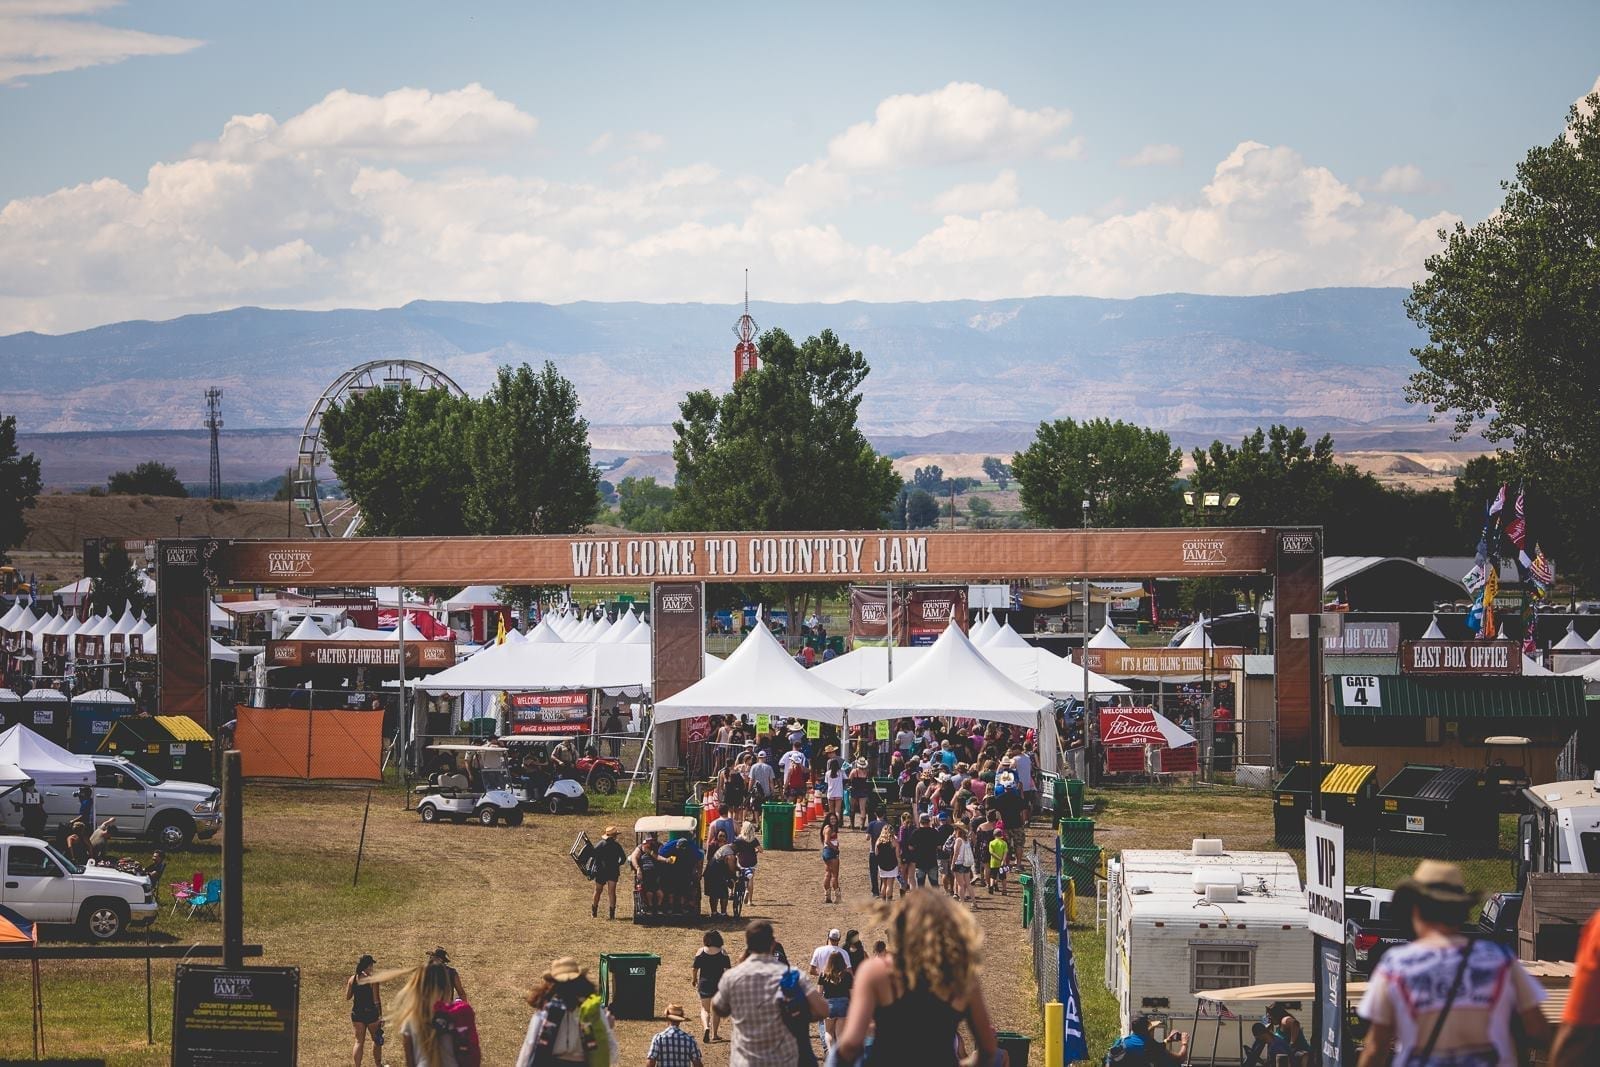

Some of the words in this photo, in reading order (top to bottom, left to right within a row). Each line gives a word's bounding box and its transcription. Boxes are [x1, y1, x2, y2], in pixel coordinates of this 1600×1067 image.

[1182, 542, 1225, 551] COUNTRY
[1282, 542, 1301, 552] JAM
[166, 553, 185, 562] JAM
[268, 552, 312, 561] COUNTRY
[570, 540, 695, 577] WELCOME
[704, 539, 738, 575] TO
[749, 538, 866, 574] COUNTRY
[873, 537, 928, 573] JAM
[1182, 549, 1207, 561] JAM
[268, 560, 295, 573] JAM
[662, 595, 693, 603] COUNTRY
[662, 602, 681, 610] JAM
[862, 604, 885, 612] COUNTRY
[862, 610, 876, 621] JAM
[922, 608, 939, 619] JAM
[317, 648, 347, 664] CACTUS
[348, 648, 381, 664] FLOWER
[383, 648, 401, 664] HAT
[1414, 646, 1441, 667] EAST
[1444, 646, 1467, 667] BOX
[1470, 646, 1508, 667] OFFICE
[1121, 657, 1135, 671] IT'S
[1136, 657, 1141, 671] A
[1142, 657, 1159, 671] GIRL
[1160, 657, 1181, 671] BLING
[1182, 656, 1204, 671] THING
[1346, 676, 1375, 687] GATE
[517, 696, 541, 705] WELCOME
[550, 696, 572, 704] COUNTRY
[573, 695, 584, 704] JAM
[1354, 687, 1368, 705] 4
[1110, 720, 1158, 735] Budwe
[1316, 836, 1336, 888] VIP
[213, 984, 235, 994] JAM
